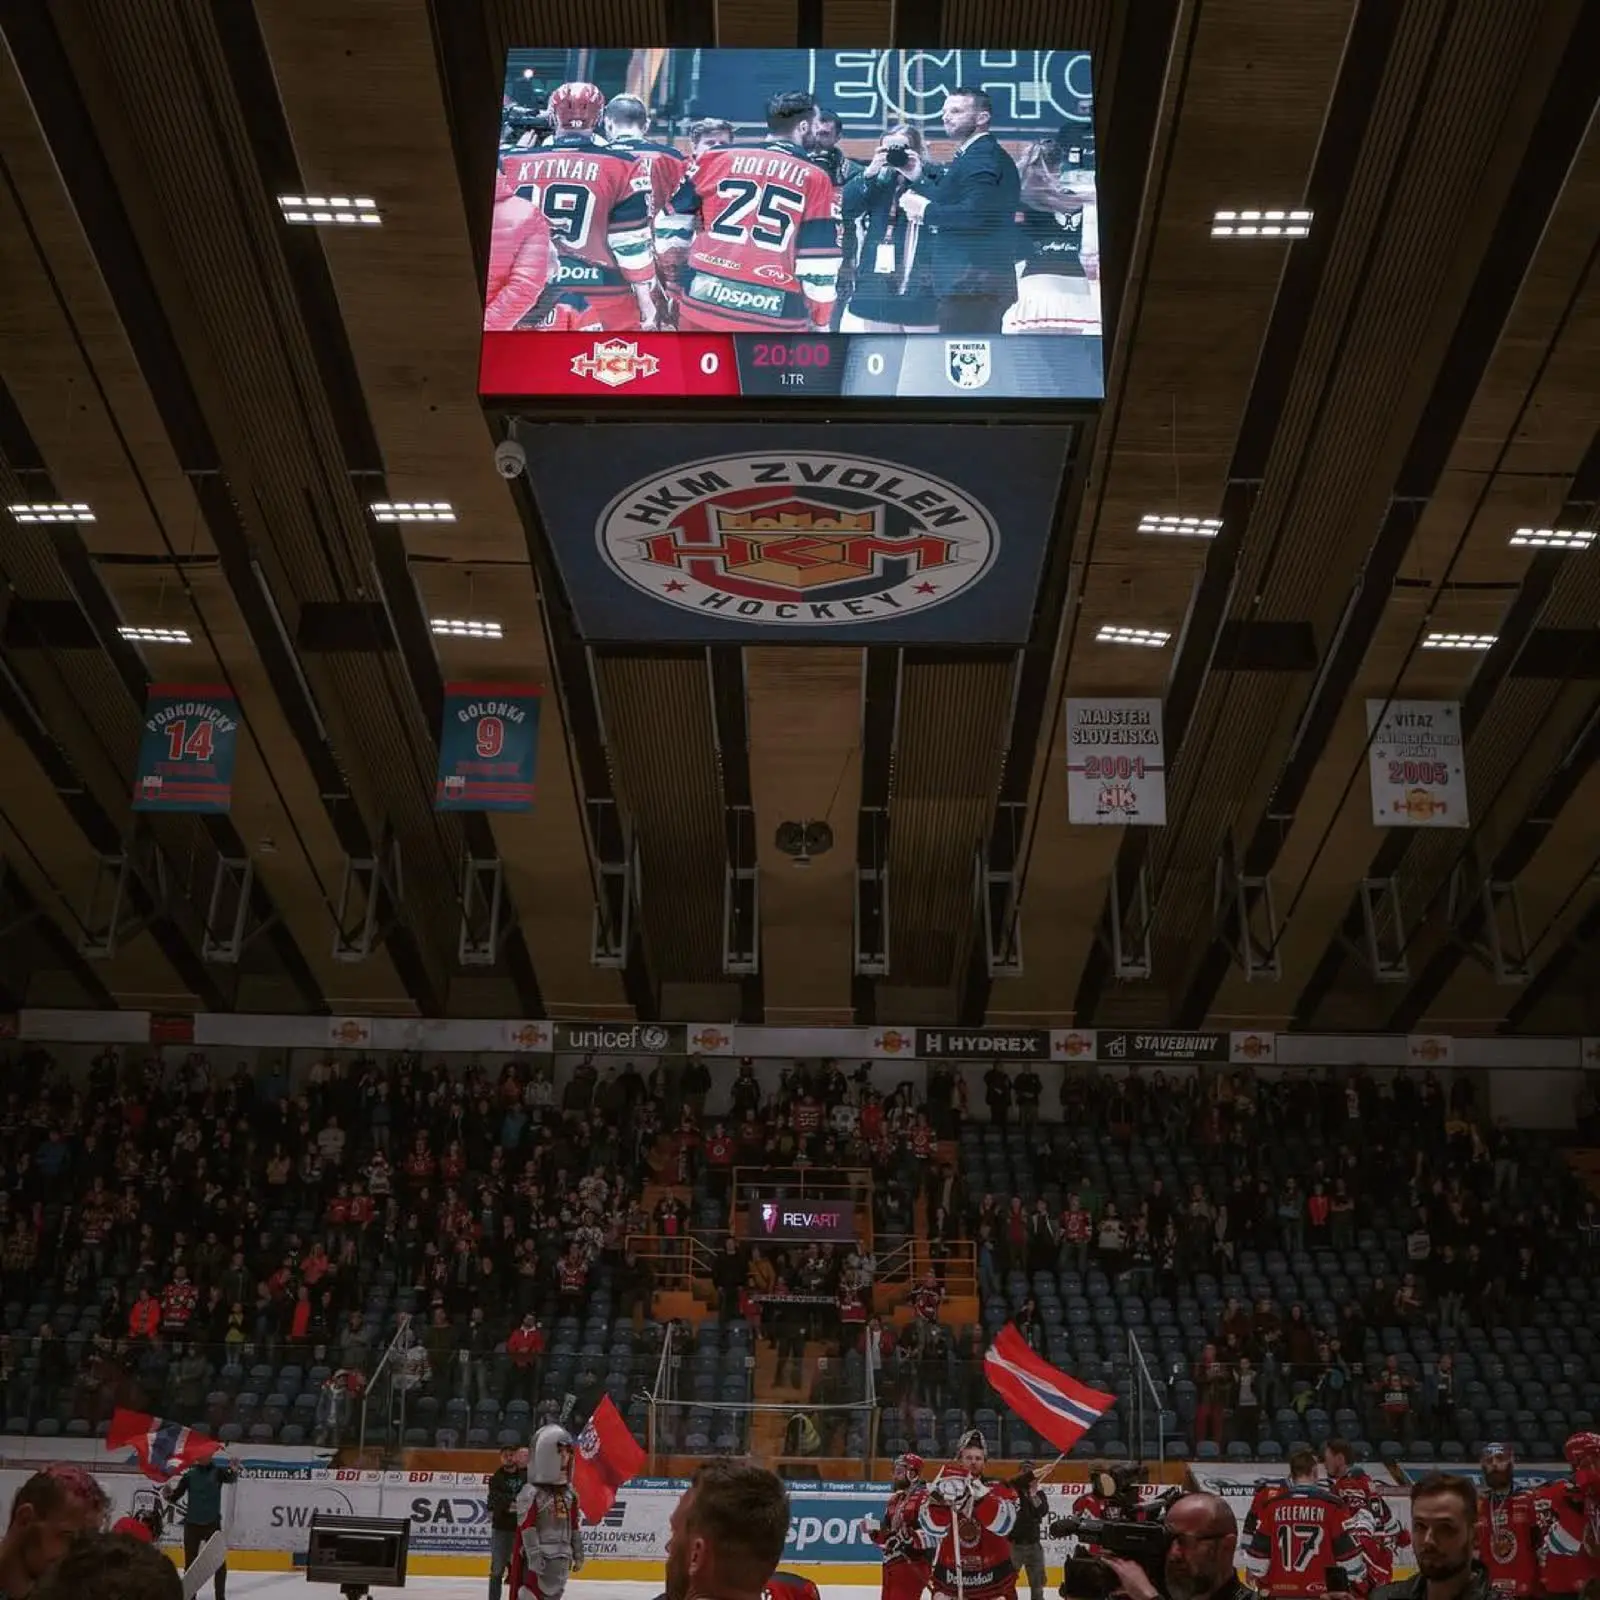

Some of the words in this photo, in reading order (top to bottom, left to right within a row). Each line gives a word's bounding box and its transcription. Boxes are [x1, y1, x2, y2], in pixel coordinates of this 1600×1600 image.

[708, 177, 806, 253] 25
[708, 281, 783, 312] Tipsport
[700, 353, 718, 374] 0
[752, 343, 831, 369] 20:00
[867, 354, 884, 374] 0
[623, 471, 733, 527] HKM
[750, 462, 970, 528] ZVOLEN
[701, 591, 905, 620] HOCKEY
[457, 702, 526, 724] GOLONKA
[1079, 709, 1151, 725] MAJSTER
[164, 720, 215, 761] 14
[476, 716, 505, 758] 9
[1072, 727, 1159, 744] SLOVENSKA
[1084, 756, 1145, 779] 2001
[1388, 761, 1448, 784] 2005
[569, 1025, 641, 1049] unicef
[948, 1036, 1037, 1052] HYDREX
[1134, 1035, 1218, 1051] STAVEBNINY
[783, 1212, 841, 1227] REVART
[336, 1470, 361, 1481] BDI
[409, 1472, 434, 1483] BDI
[1061, 1485, 1085, 1495] BDI
[1274, 1505, 1325, 1522] KELEMEN
[419, 1526, 488, 1535] KRUPINA
[1277, 1523, 1324, 1572] 17
